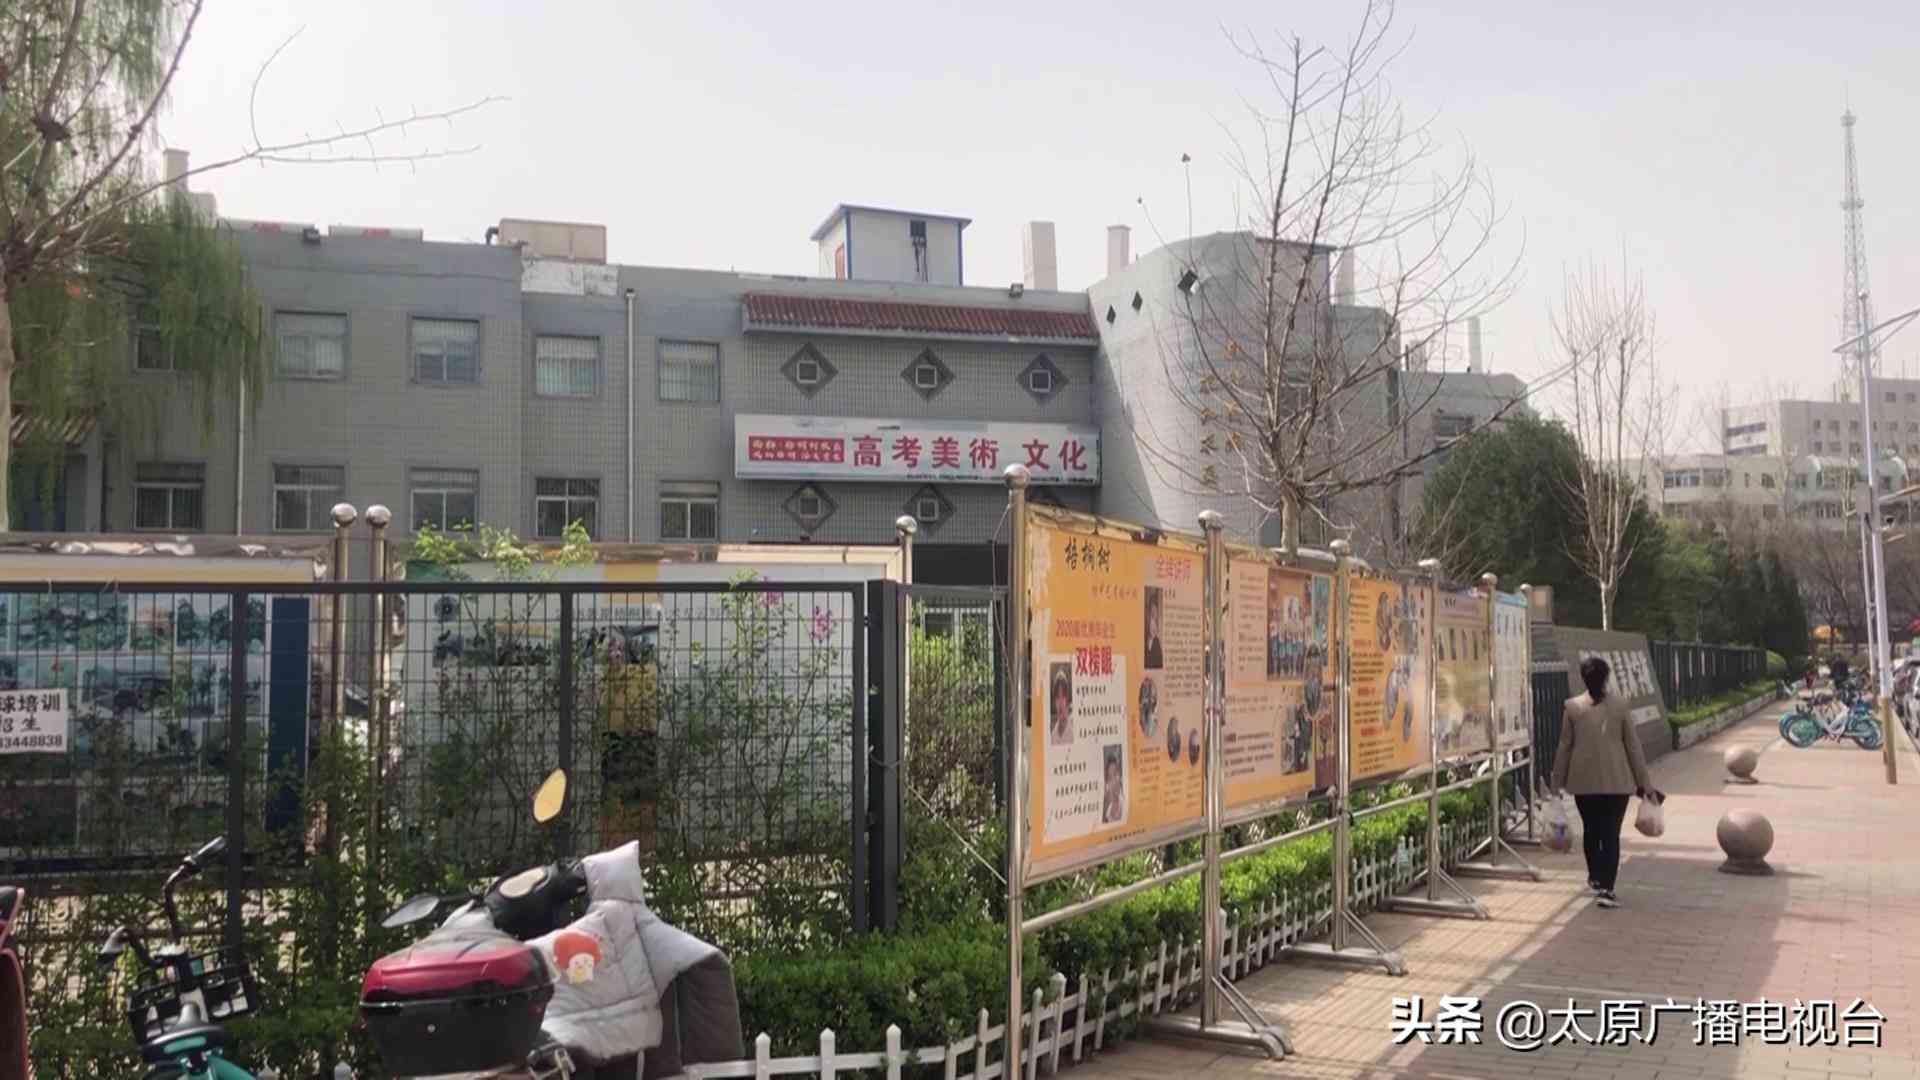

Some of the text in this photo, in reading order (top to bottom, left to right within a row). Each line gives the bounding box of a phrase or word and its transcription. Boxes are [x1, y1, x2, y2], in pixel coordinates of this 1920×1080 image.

[853, 436, 1088, 471] 高考美術 文化
[1075, 645, 1113, 677] 双榜眼
